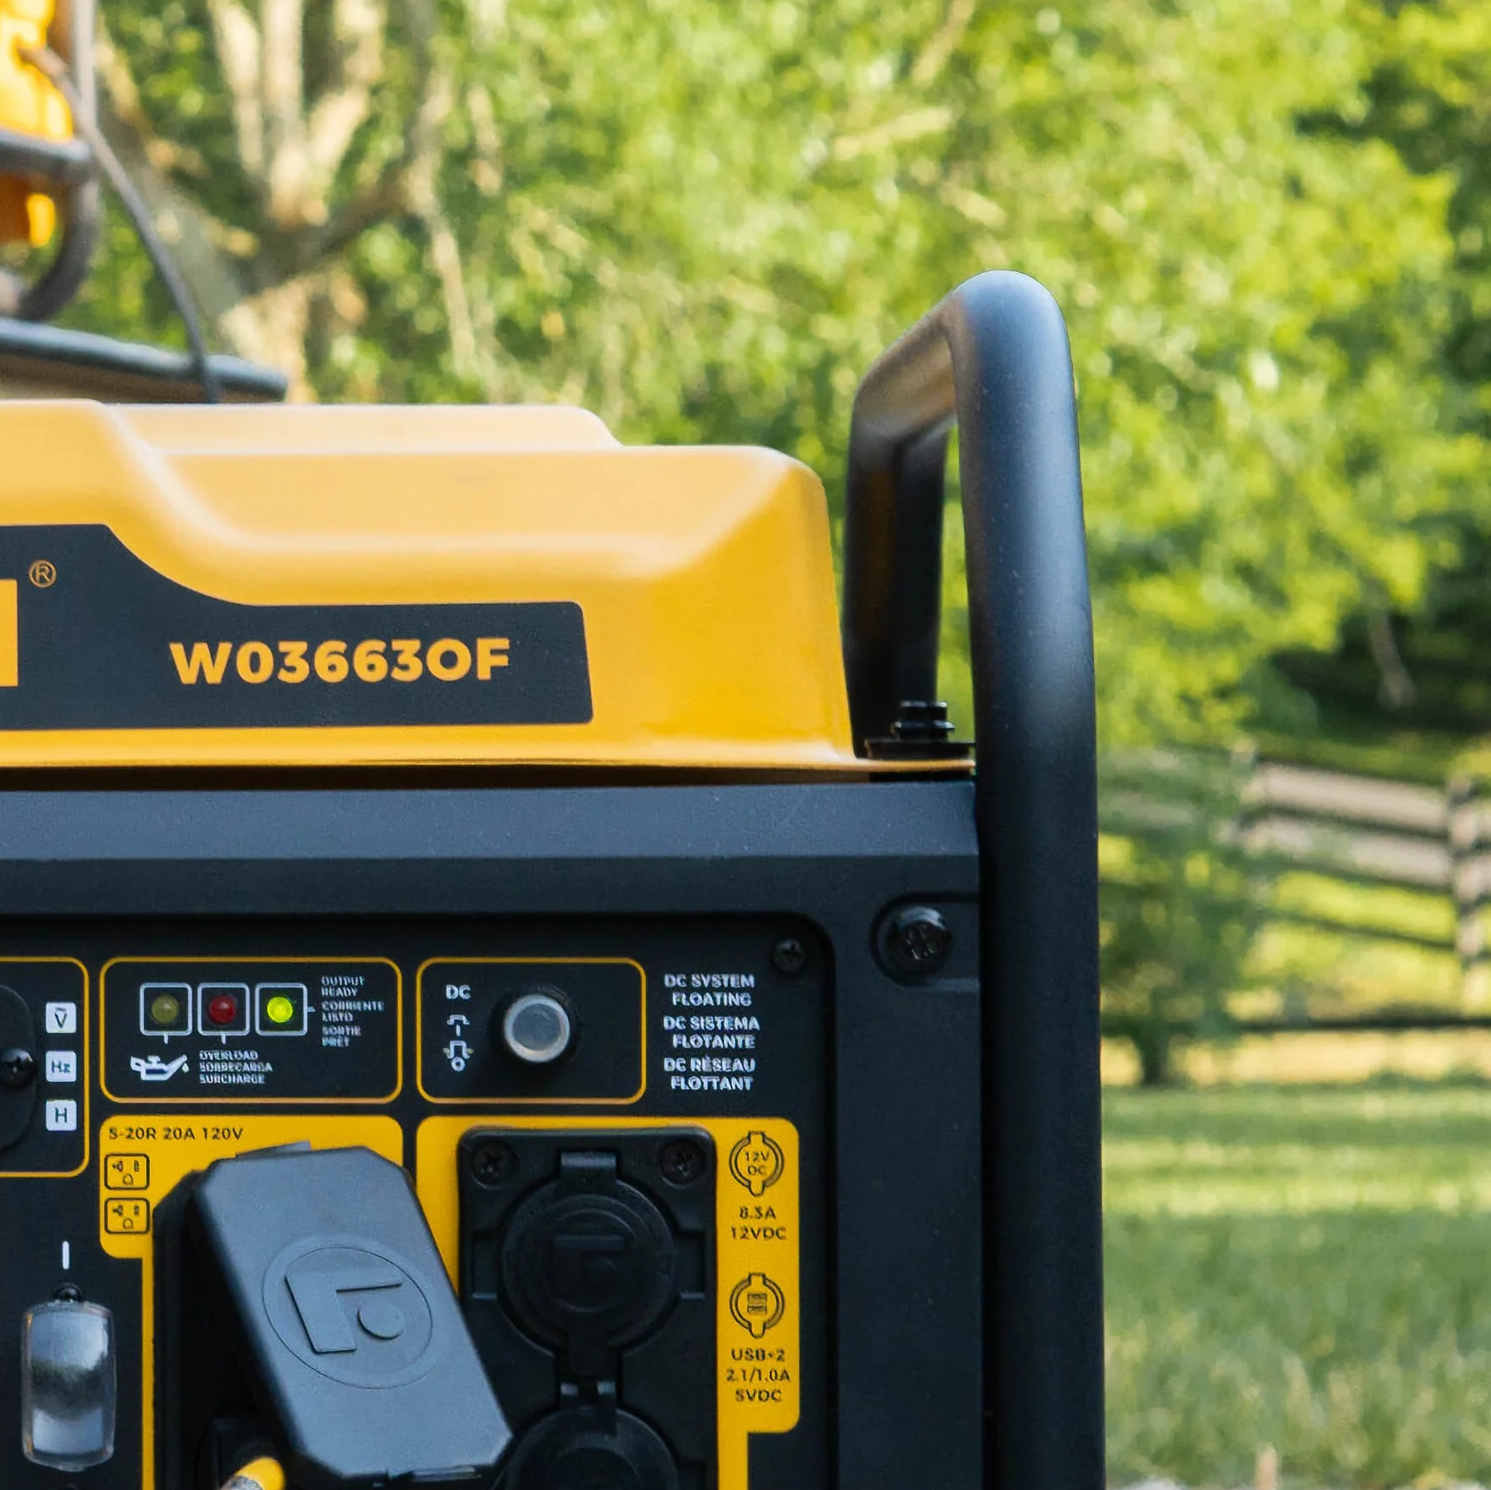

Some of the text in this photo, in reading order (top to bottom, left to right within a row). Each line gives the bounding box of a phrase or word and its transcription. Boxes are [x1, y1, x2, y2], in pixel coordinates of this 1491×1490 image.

[446, 985, 470, 999] DC
[673, 992, 751, 1006] FLOATING
[673, 1034, 755, 1048] FLOTANTE
[671, 1076, 752, 1090] FLOTTANT
[56, 1108, 67, 1122] H
[745, 1152, 770, 1162] 12V
